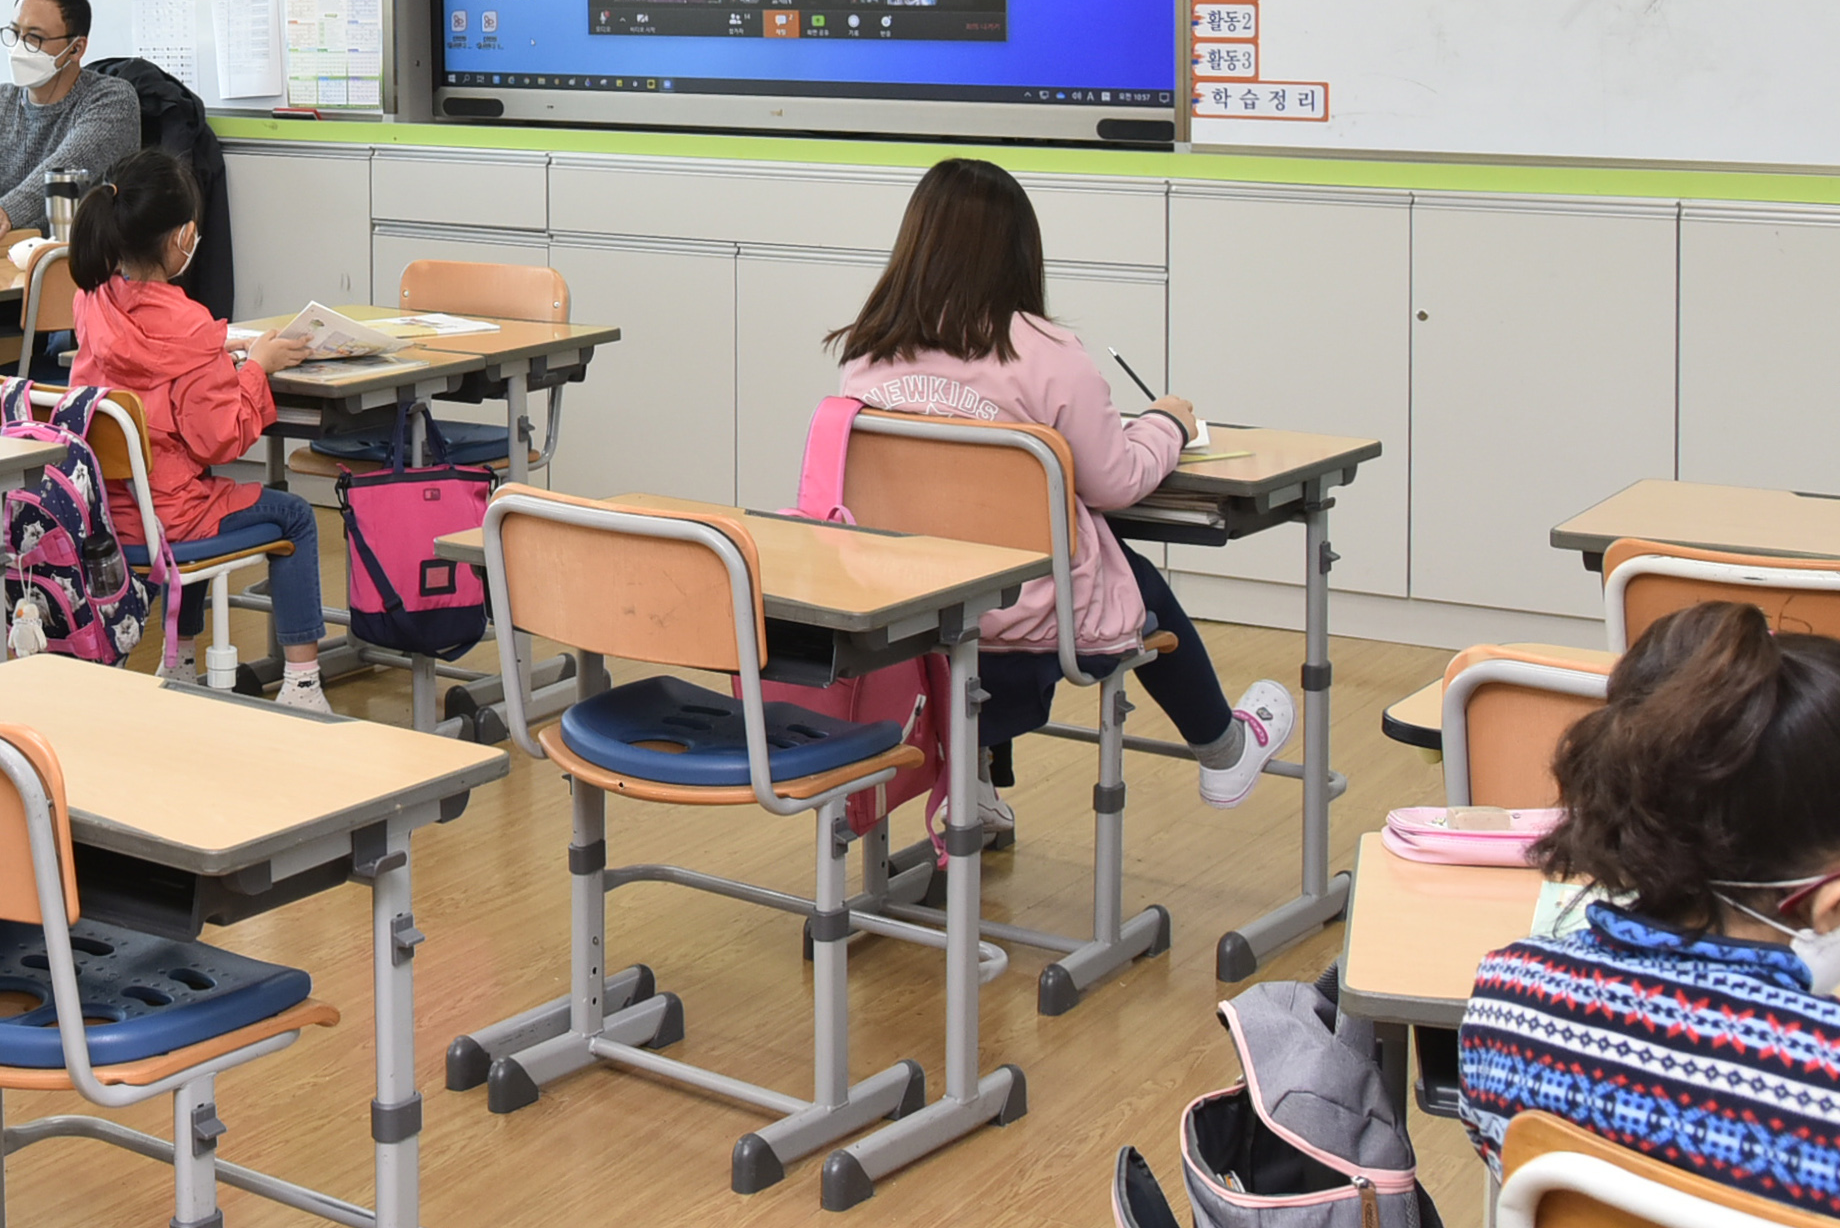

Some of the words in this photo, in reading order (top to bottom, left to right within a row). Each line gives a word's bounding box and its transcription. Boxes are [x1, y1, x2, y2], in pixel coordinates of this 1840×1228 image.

[1206, 10, 1253, 33] 활동2
[1206, 48, 1253, 72] 활동3
[1211, 86, 1316, 112] 학습정리
